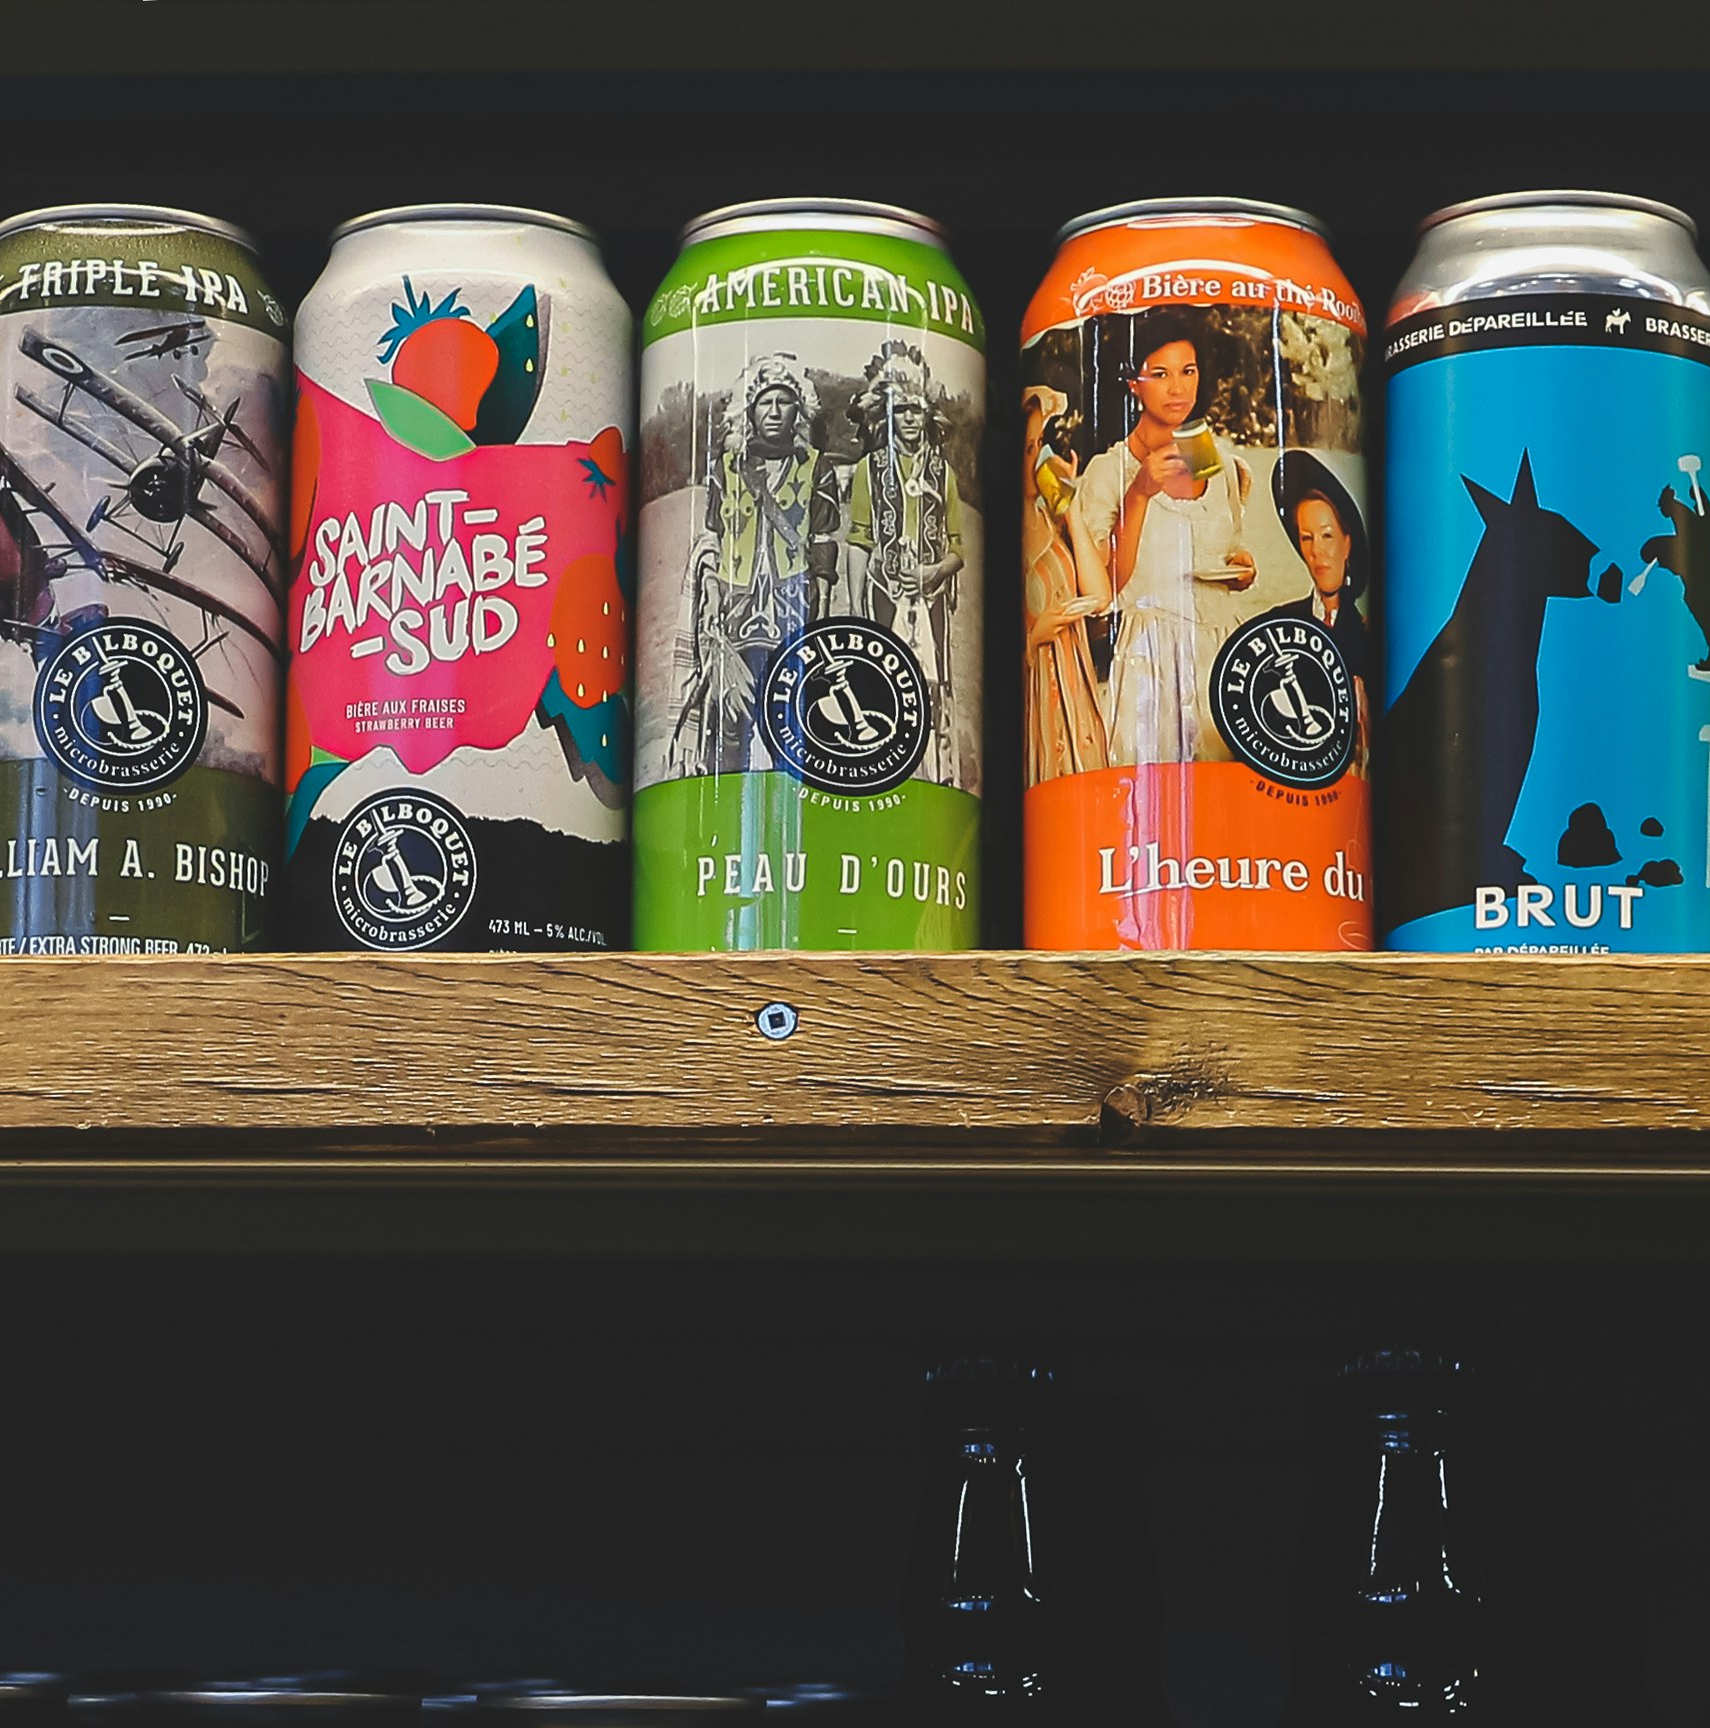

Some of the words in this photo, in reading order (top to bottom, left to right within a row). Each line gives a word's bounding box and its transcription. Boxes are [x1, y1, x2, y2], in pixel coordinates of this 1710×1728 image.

[19, 257, 162, 298] TRIPLE
[183, 263, 249, 314] IPA
[699, 265, 910, 315] AMERICAN
[925, 280, 974, 335] IPA
[1141, 273, 1221, 299] Bière
[1448, 309, 1589, 338] DÉPAREILLÉE
[309, 488, 500, 588] SAINT-
[299, 515, 549, 654] BARNABÉ
[350, 594, 520, 676] -SUD
[345, 700, 379, 719] BIÈRE
[382, 700, 408, 715] AUX
[411, 697, 467, 714] FRAISES
[355, 717, 421, 734] STRAWBERRY
[424, 716, 455, 730] BEER
[68, 788, 131, 814] DEPUIS
[868, 794, 902, 813] 1990
[1255, 779, 1309, 807] DEPUIS
[175, 843, 269, 897] BISHOP
[696, 851, 808, 897] PEAU
[839, 853, 968, 911] D'OURS
[1097, 841, 1310, 895] L'heure
[1323, 849, 1365, 902] du
[488, 919, 511, 935] 473
[1474, 883, 1644, 930] BRUT
